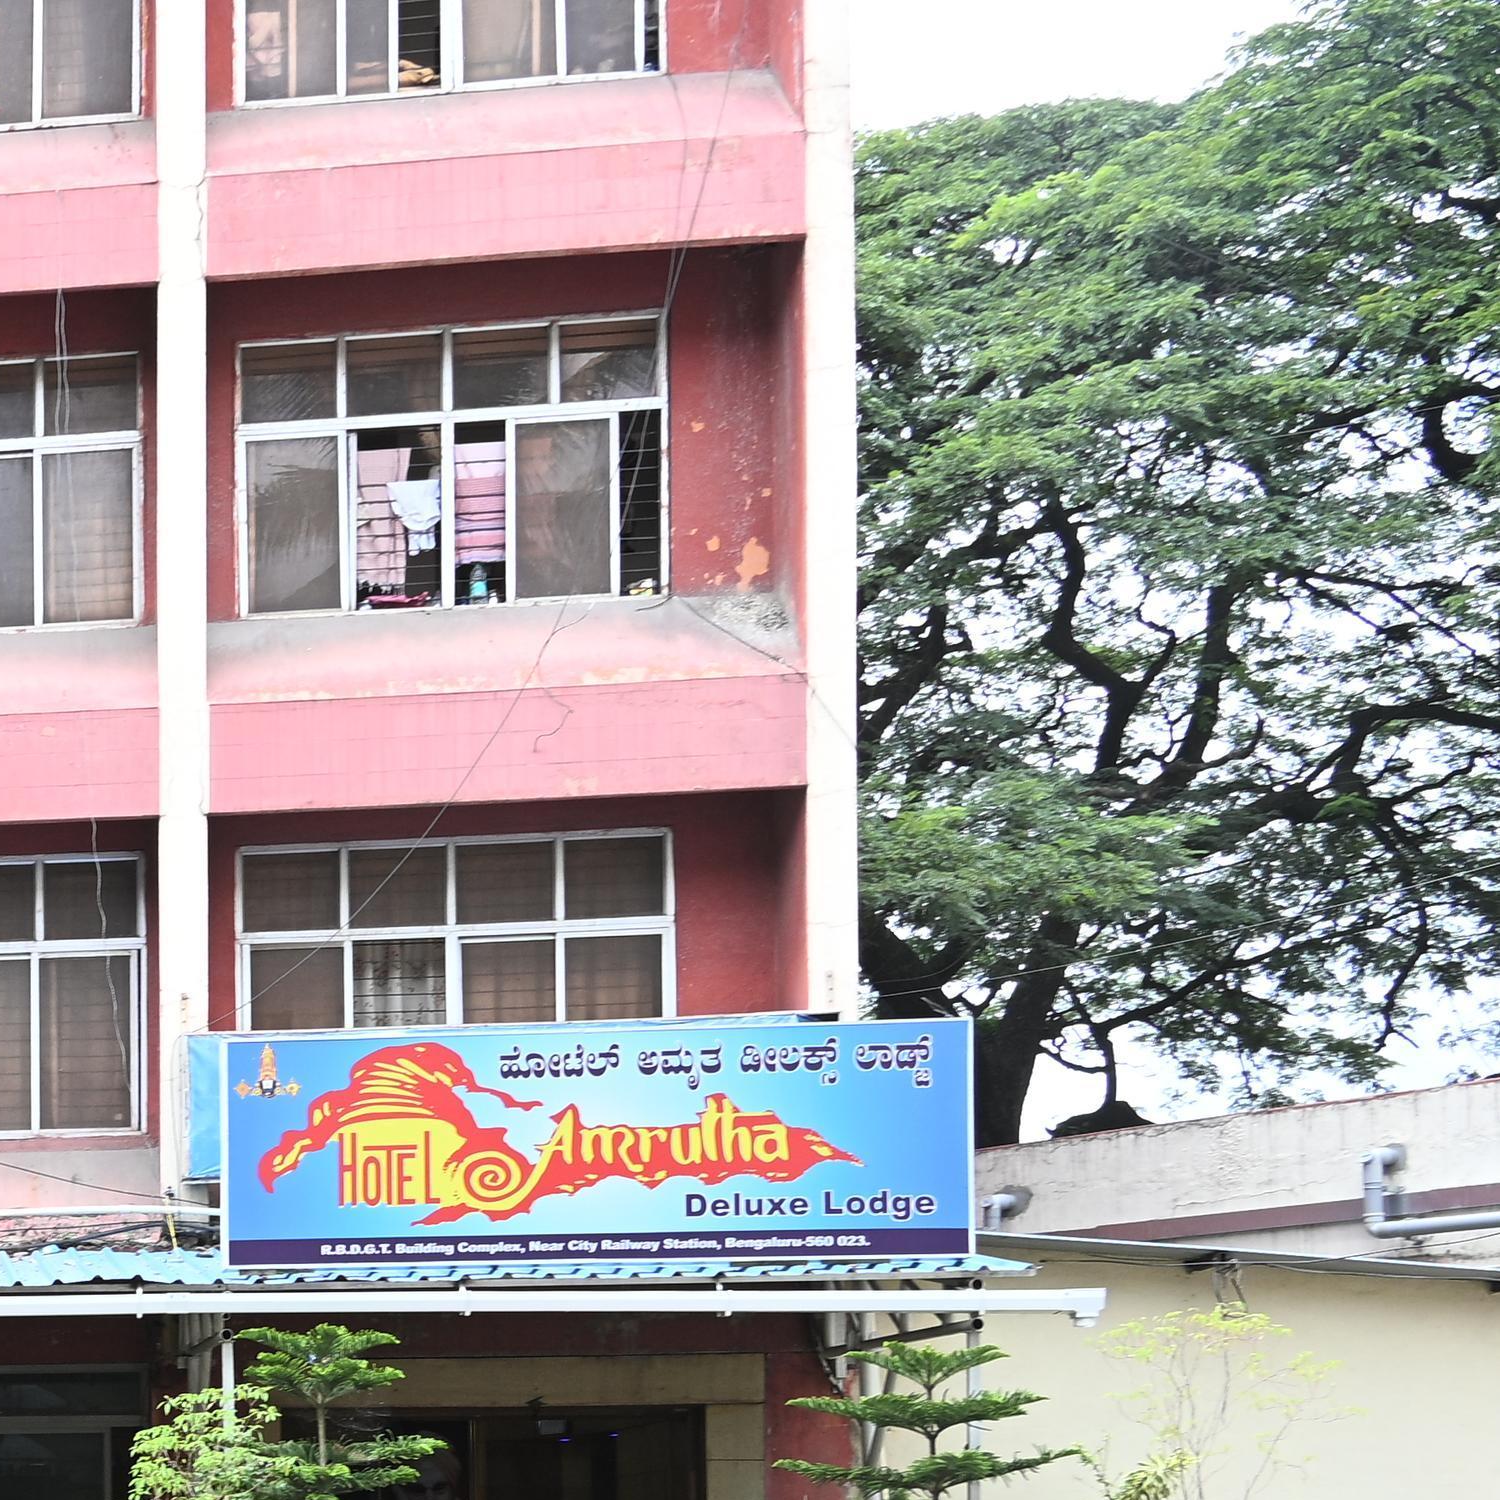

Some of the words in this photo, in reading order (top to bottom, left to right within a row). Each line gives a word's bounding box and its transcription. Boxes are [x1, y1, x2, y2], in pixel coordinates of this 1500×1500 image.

[499, 1043, 620, 1079] ಹೋಟೆಲ್
[637, 1040, 723, 1090] ಅಮೃತ
[855, 1035, 931, 1087] ಲಾಡ್ಜ್
[535, 1097, 790, 1174] Amrutha
[686, 1194, 808, 1218] Deluxe
[825, 1191, 936, 1219] Lodge
[395, 1243, 454, 1255] Building
[457, 1241, 527, 1255] Complex,
[529, 1241, 565, 1253] Near
[567, 1240, 599, 1253] City
[600, 1238, 660, 1252] Railway
[663, 1238, 722, 1250] Station,
